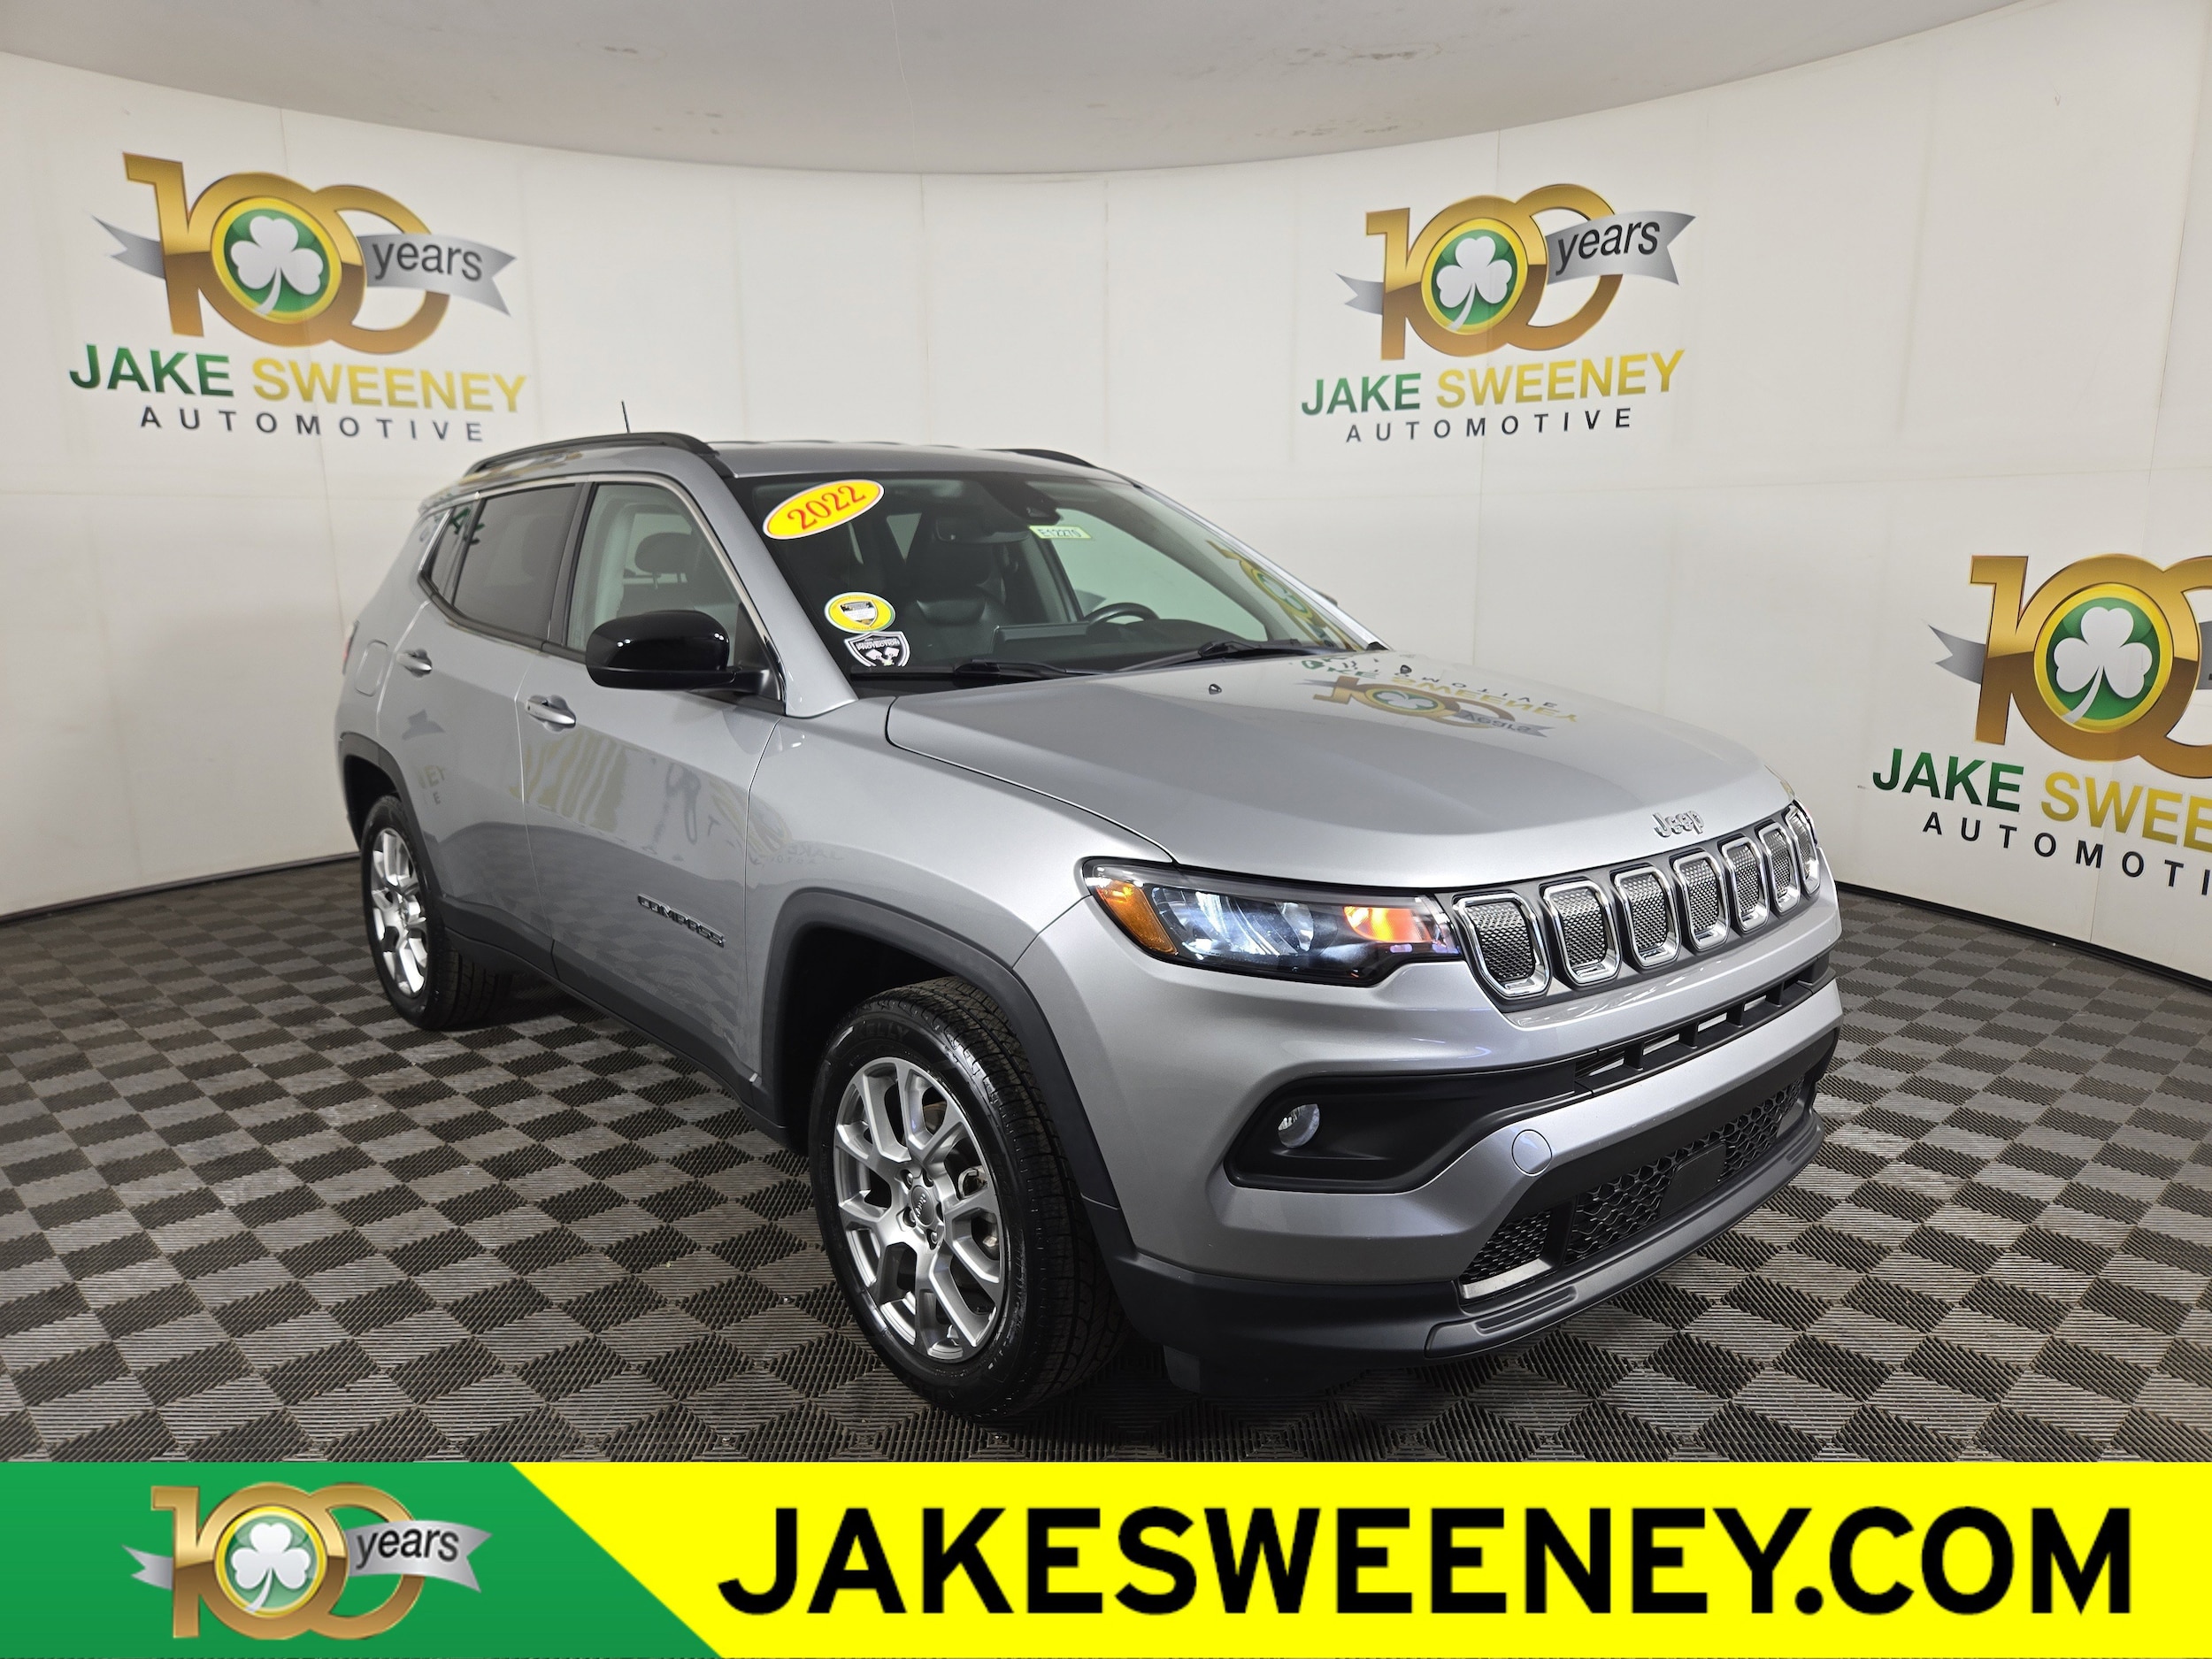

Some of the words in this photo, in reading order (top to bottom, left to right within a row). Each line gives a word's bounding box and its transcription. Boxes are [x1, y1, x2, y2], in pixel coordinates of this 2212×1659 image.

[123, 152, 449, 354] 100
[373, 239, 484, 281] years
[1365, 183, 1623, 361] 100
[1555, 219, 1662, 276] years
[69, 343, 234, 397] JAKE
[252, 357, 527, 412] SWEENEY
[1302, 373, 1422, 416] JAKE
[1436, 349, 1686, 409] SWEENEY
[140, 406, 484, 442] AUTOMOTIVE
[1346, 407, 1632, 443] AUTOMOTIVE
[787, 484, 866, 531] 2022
[1872, 747, 2024, 812] JAKE
[1652, 810, 1704, 838] Jeep
[1922, 810, 2210, 896] AUTOMOTI
[638, 893, 726, 949] COMPASS
